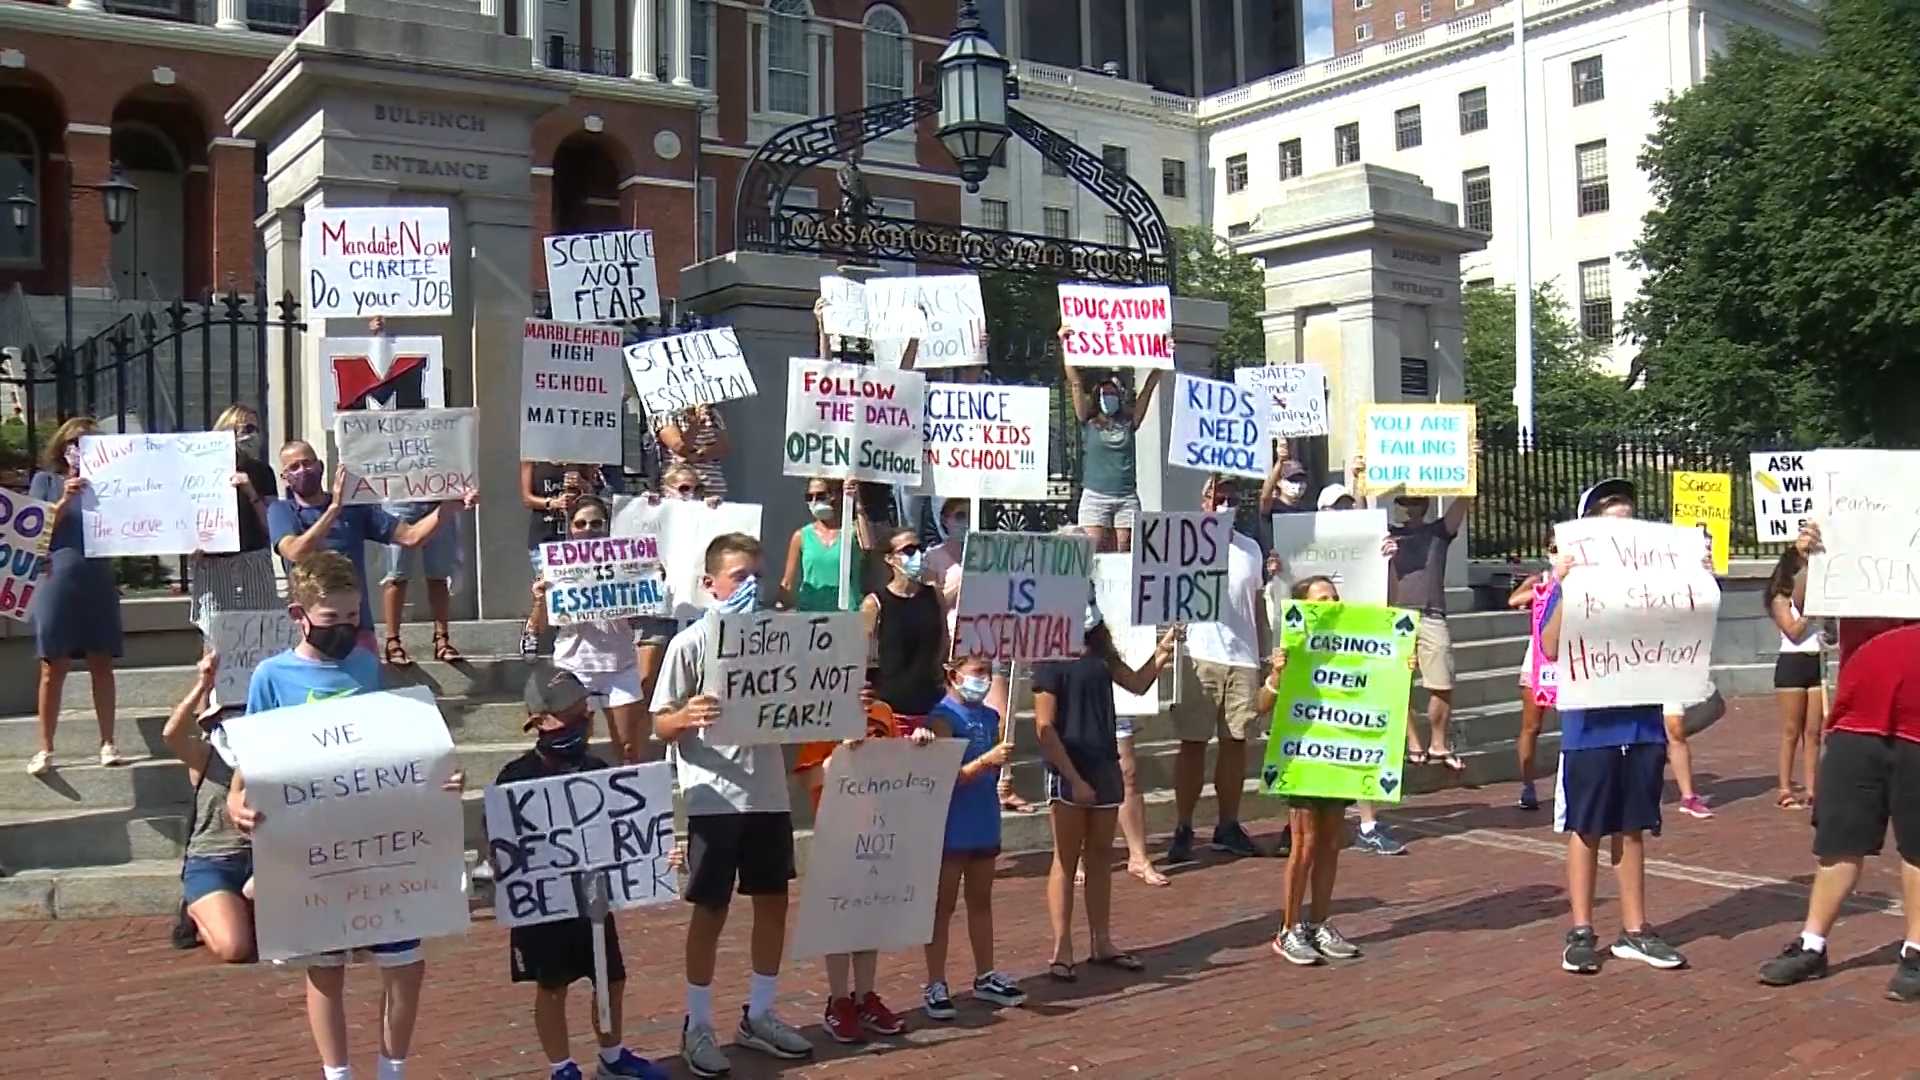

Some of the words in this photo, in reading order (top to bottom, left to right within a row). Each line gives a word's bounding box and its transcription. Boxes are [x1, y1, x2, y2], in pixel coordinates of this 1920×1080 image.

[374, 105, 486, 133] BULFINCH
[371, 154, 489, 180] ENTRANCE
[552, 232, 655, 268] SCIENCE
[350, 258, 437, 279] CHARLIE
[581, 261, 640, 286] NOT
[311, 269, 340, 309] Do
[353, 291, 400, 315] your
[408, 277, 450, 309] JOB
[575, 287, 646, 320] FEAR
[1064, 296, 1166, 320] EDUCATION
[524, 323, 620, 347] MARBLEHEAD
[1066, 330, 1171, 358] ESSENTIAL
[551, 343, 594, 361] HIGH
[629, 330, 741, 372] SCHOOLS
[535, 373, 608, 394] SCHOOL
[667, 364, 711, 385] ARE
[804, 372, 896, 399] FOLLOW
[816, 401, 854, 422] THE
[1188, 379, 1256, 418] KIDS
[527, 407, 616, 428] MATTERS
[1370, 416, 1411, 431] YOU
[1421, 416, 1460, 431] ARE
[1200, 417, 1258, 446] NEED
[389, 436, 433, 456] HERE
[787, 432, 850, 466] OPEN
[1186, 441, 1264, 472] SCHOOL
[1380, 439, 1456, 455] FAILING
[409, 458, 438, 469] ARE
[1368, 465, 1410, 481] OUR
[1419, 465, 1466, 481] KIDS
[1768, 455, 1804, 472] ASK
[352, 475, 400, 499] AT
[405, 472, 474, 496] WORK
[1762, 499, 1767, 514] I
[121, 520, 163, 537] curve
[1770, 519, 1787, 535] IN
[546, 537, 658, 566] EDUCATION
[1142, 517, 1218, 566] KIDS
[1568, 536, 1599, 567] I
[1611, 536, 1679, 570] Want
[964, 535, 1089, 577] EDUCATION
[593, 564, 615, 580] IS
[551, 579, 663, 614] ESSENTIAL
[1008, 579, 1036, 614] IS
[1138, 569, 1228, 624] FIRST
[1625, 584, 1696, 612] Start
[808, 616, 833, 651] To
[952, 613, 1083, 660] ESSENTIAL
[1310, 634, 1392, 656] CASINOS
[1568, 634, 1620, 682] High
[1624, 639, 1702, 667] School
[726, 664, 797, 700] FACTS
[810, 665, 858, 693] NOT
[1313, 668, 1368, 689] OPEN
[757, 701, 833, 729] FEAR!!
[1293, 702, 1388, 729] SCHOOLS
[312, 722, 363, 748] WE
[1282, 740, 1384, 764] CLOSED??
[283, 760, 427, 806] DESERVE
[838, 772, 936, 796] Technology
[506, 769, 647, 836] KIDS
[308, 830, 432, 866] BETTER
[490, 812, 675, 882] DESERVE
[855, 833, 896, 854] NOT
[304, 893, 329, 907] IN
